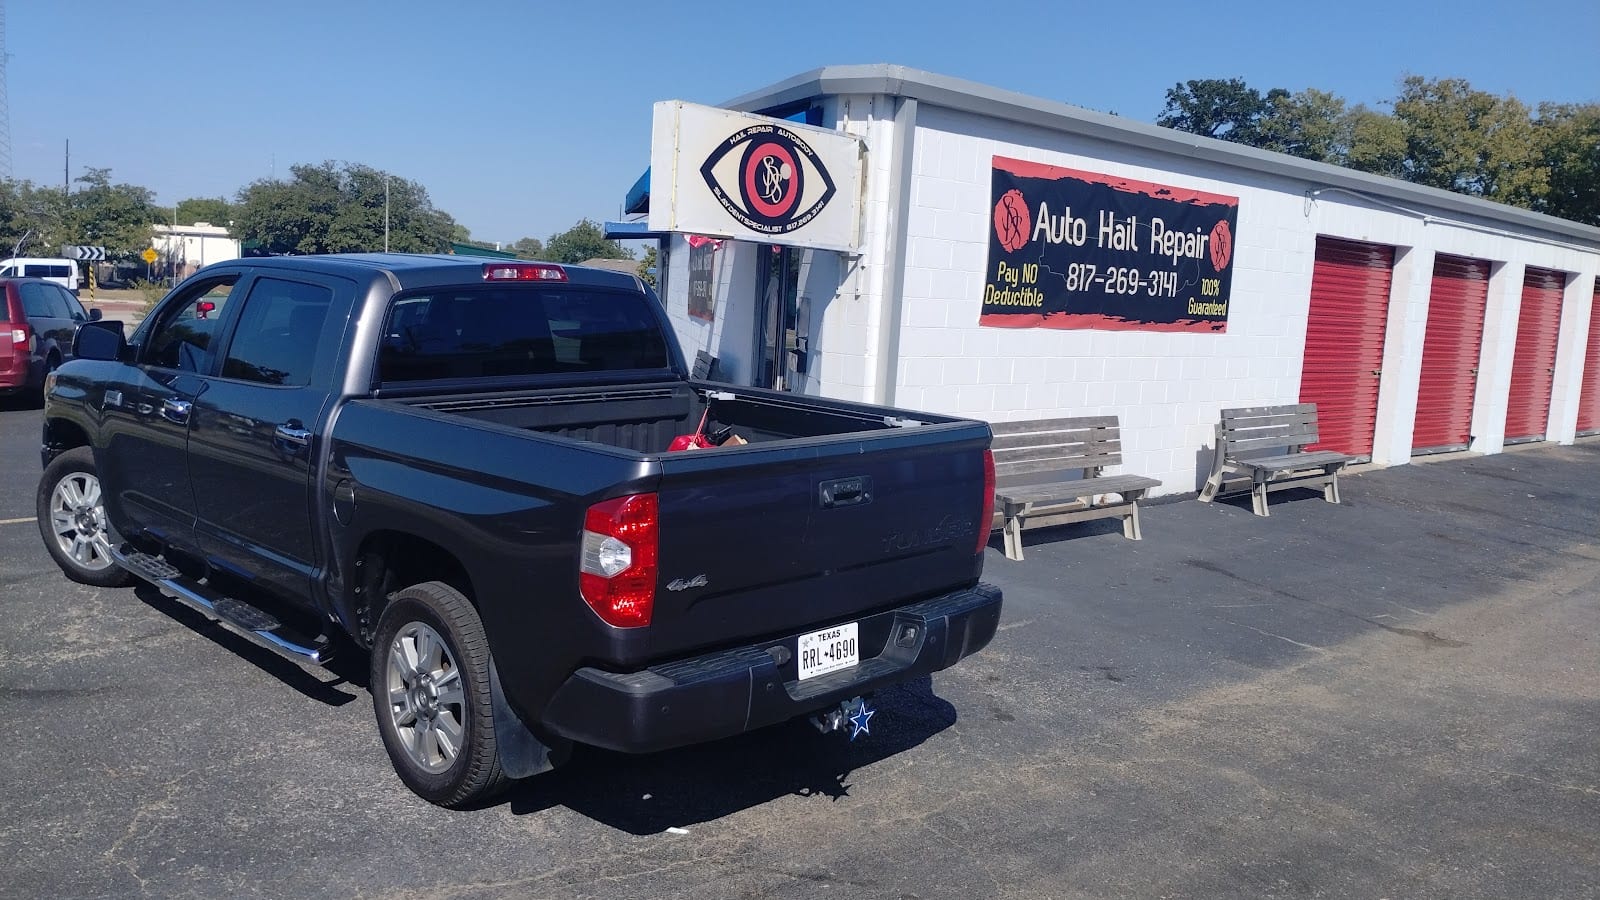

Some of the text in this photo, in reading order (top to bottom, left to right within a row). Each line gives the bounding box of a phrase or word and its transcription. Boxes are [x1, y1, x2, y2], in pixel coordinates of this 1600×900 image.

[729, 125, 814, 157] HAIL REPAIR AUTOBODY
[1032, 201, 1209, 266] Auto Hail Repair
[997, 260, 1038, 287] Pay NO
[1066, 262, 1178, 297] 817-269-3141
[985, 284, 1044, 308] Deductible
[1201, 278, 1220, 296] 100%
[1188, 297, 1227, 316] Guaranteed
[817, 629, 841, 642] TEXAS
